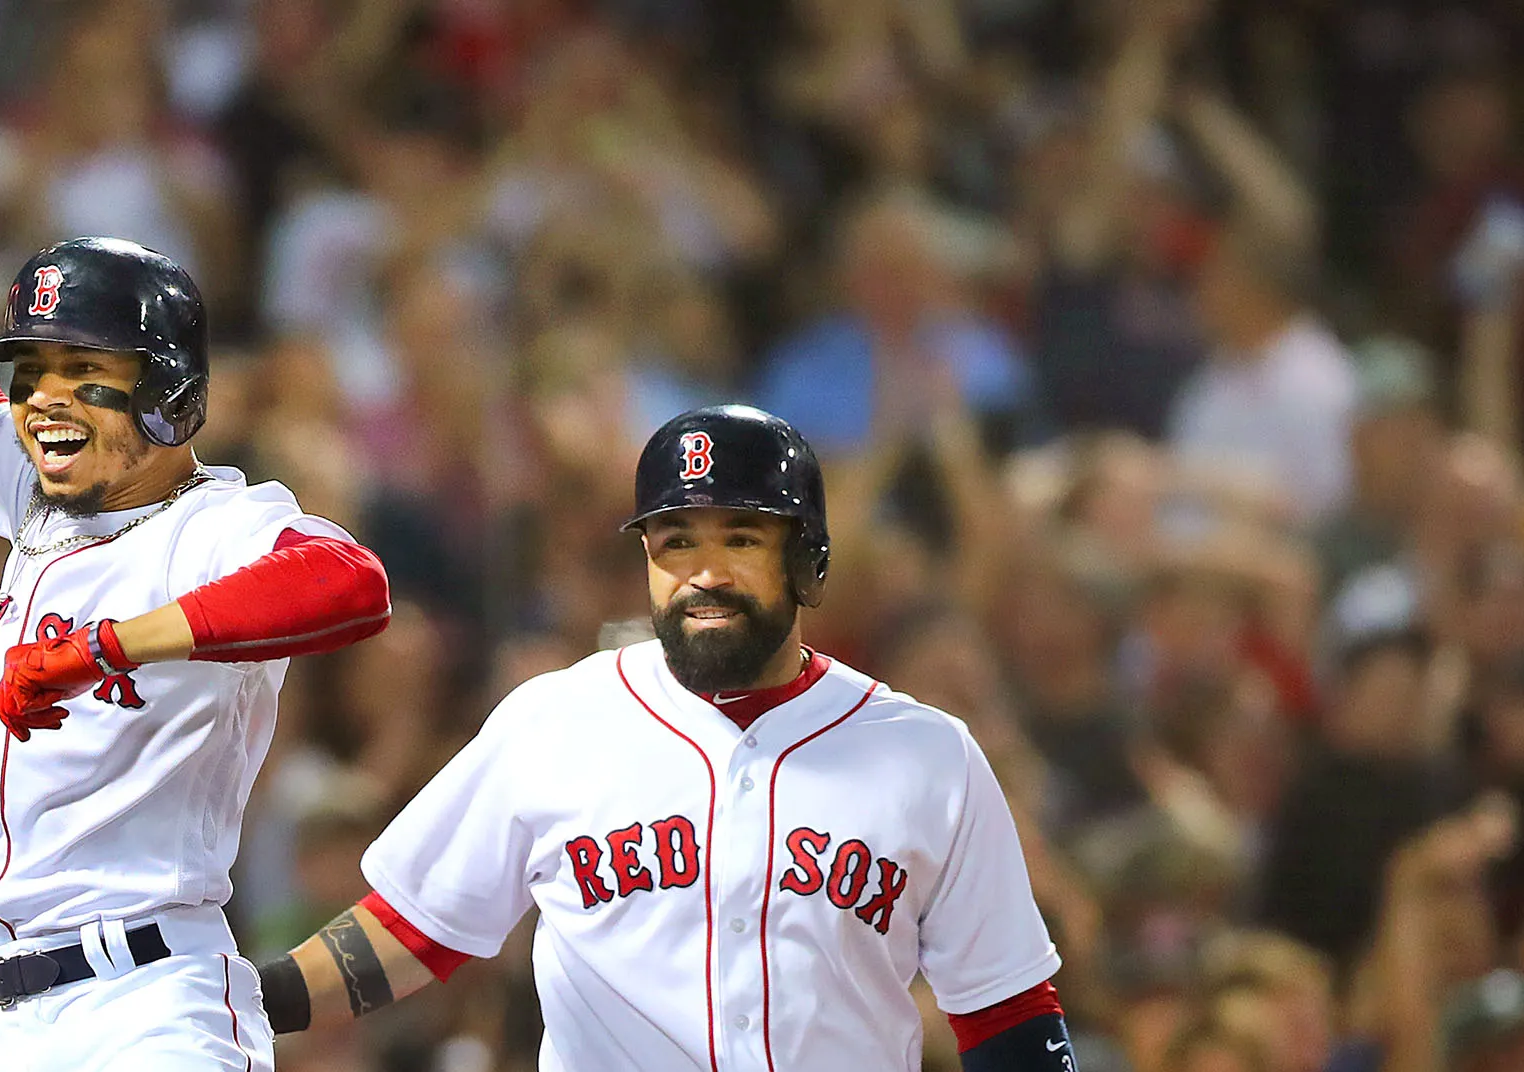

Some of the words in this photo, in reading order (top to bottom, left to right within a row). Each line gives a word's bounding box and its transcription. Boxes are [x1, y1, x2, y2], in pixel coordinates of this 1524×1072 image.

[28, 265, 64, 316] B
[679, 431, 715, 480] B
[565, 815, 701, 910] RED
[779, 826, 908, 936] SOX
